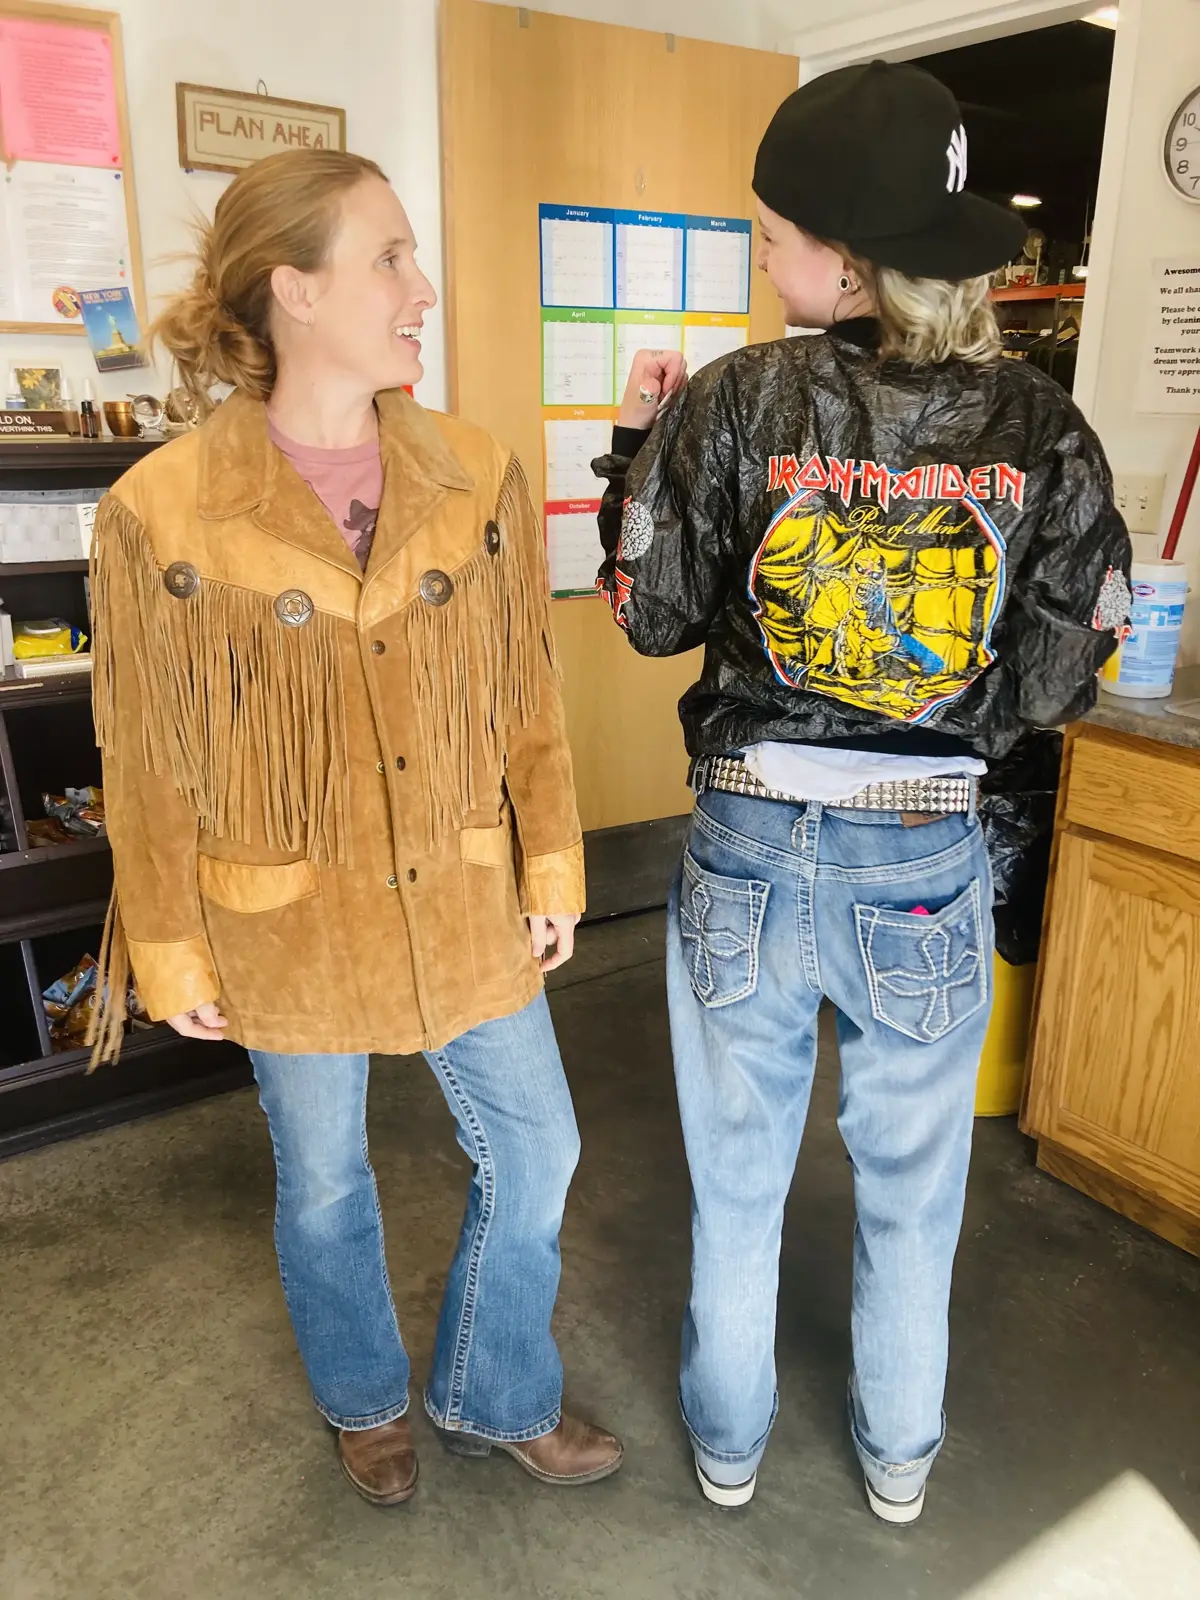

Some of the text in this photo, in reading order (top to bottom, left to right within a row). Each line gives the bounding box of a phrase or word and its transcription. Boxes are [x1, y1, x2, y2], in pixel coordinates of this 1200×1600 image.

[1182, 112, 1196, 127] 10
[200, 110, 264, 141] PLAN
[1176, 137, 1188, 151] 9
[946, 123, 967, 193] NY
[1176, 160, 1189, 174] 8
[1189, 176, 1200, 190] 7
[566, 209, 590, 218] January
[638, 214, 663, 223] February
[710, 220, 727, 228] March
[571, 311, 586, 319] April
[1161, 317, 1171, 325] by
[1159, 369, 1176, 377] very
[1166, 386, 1191, 394] Thank
[15, 415, 35, 426] ON,
[37, 425, 55, 433] THIS.
[766, 453, 1026, 513] IRON MAIDEN
[847, 505, 974, 543] Piece of Mind
